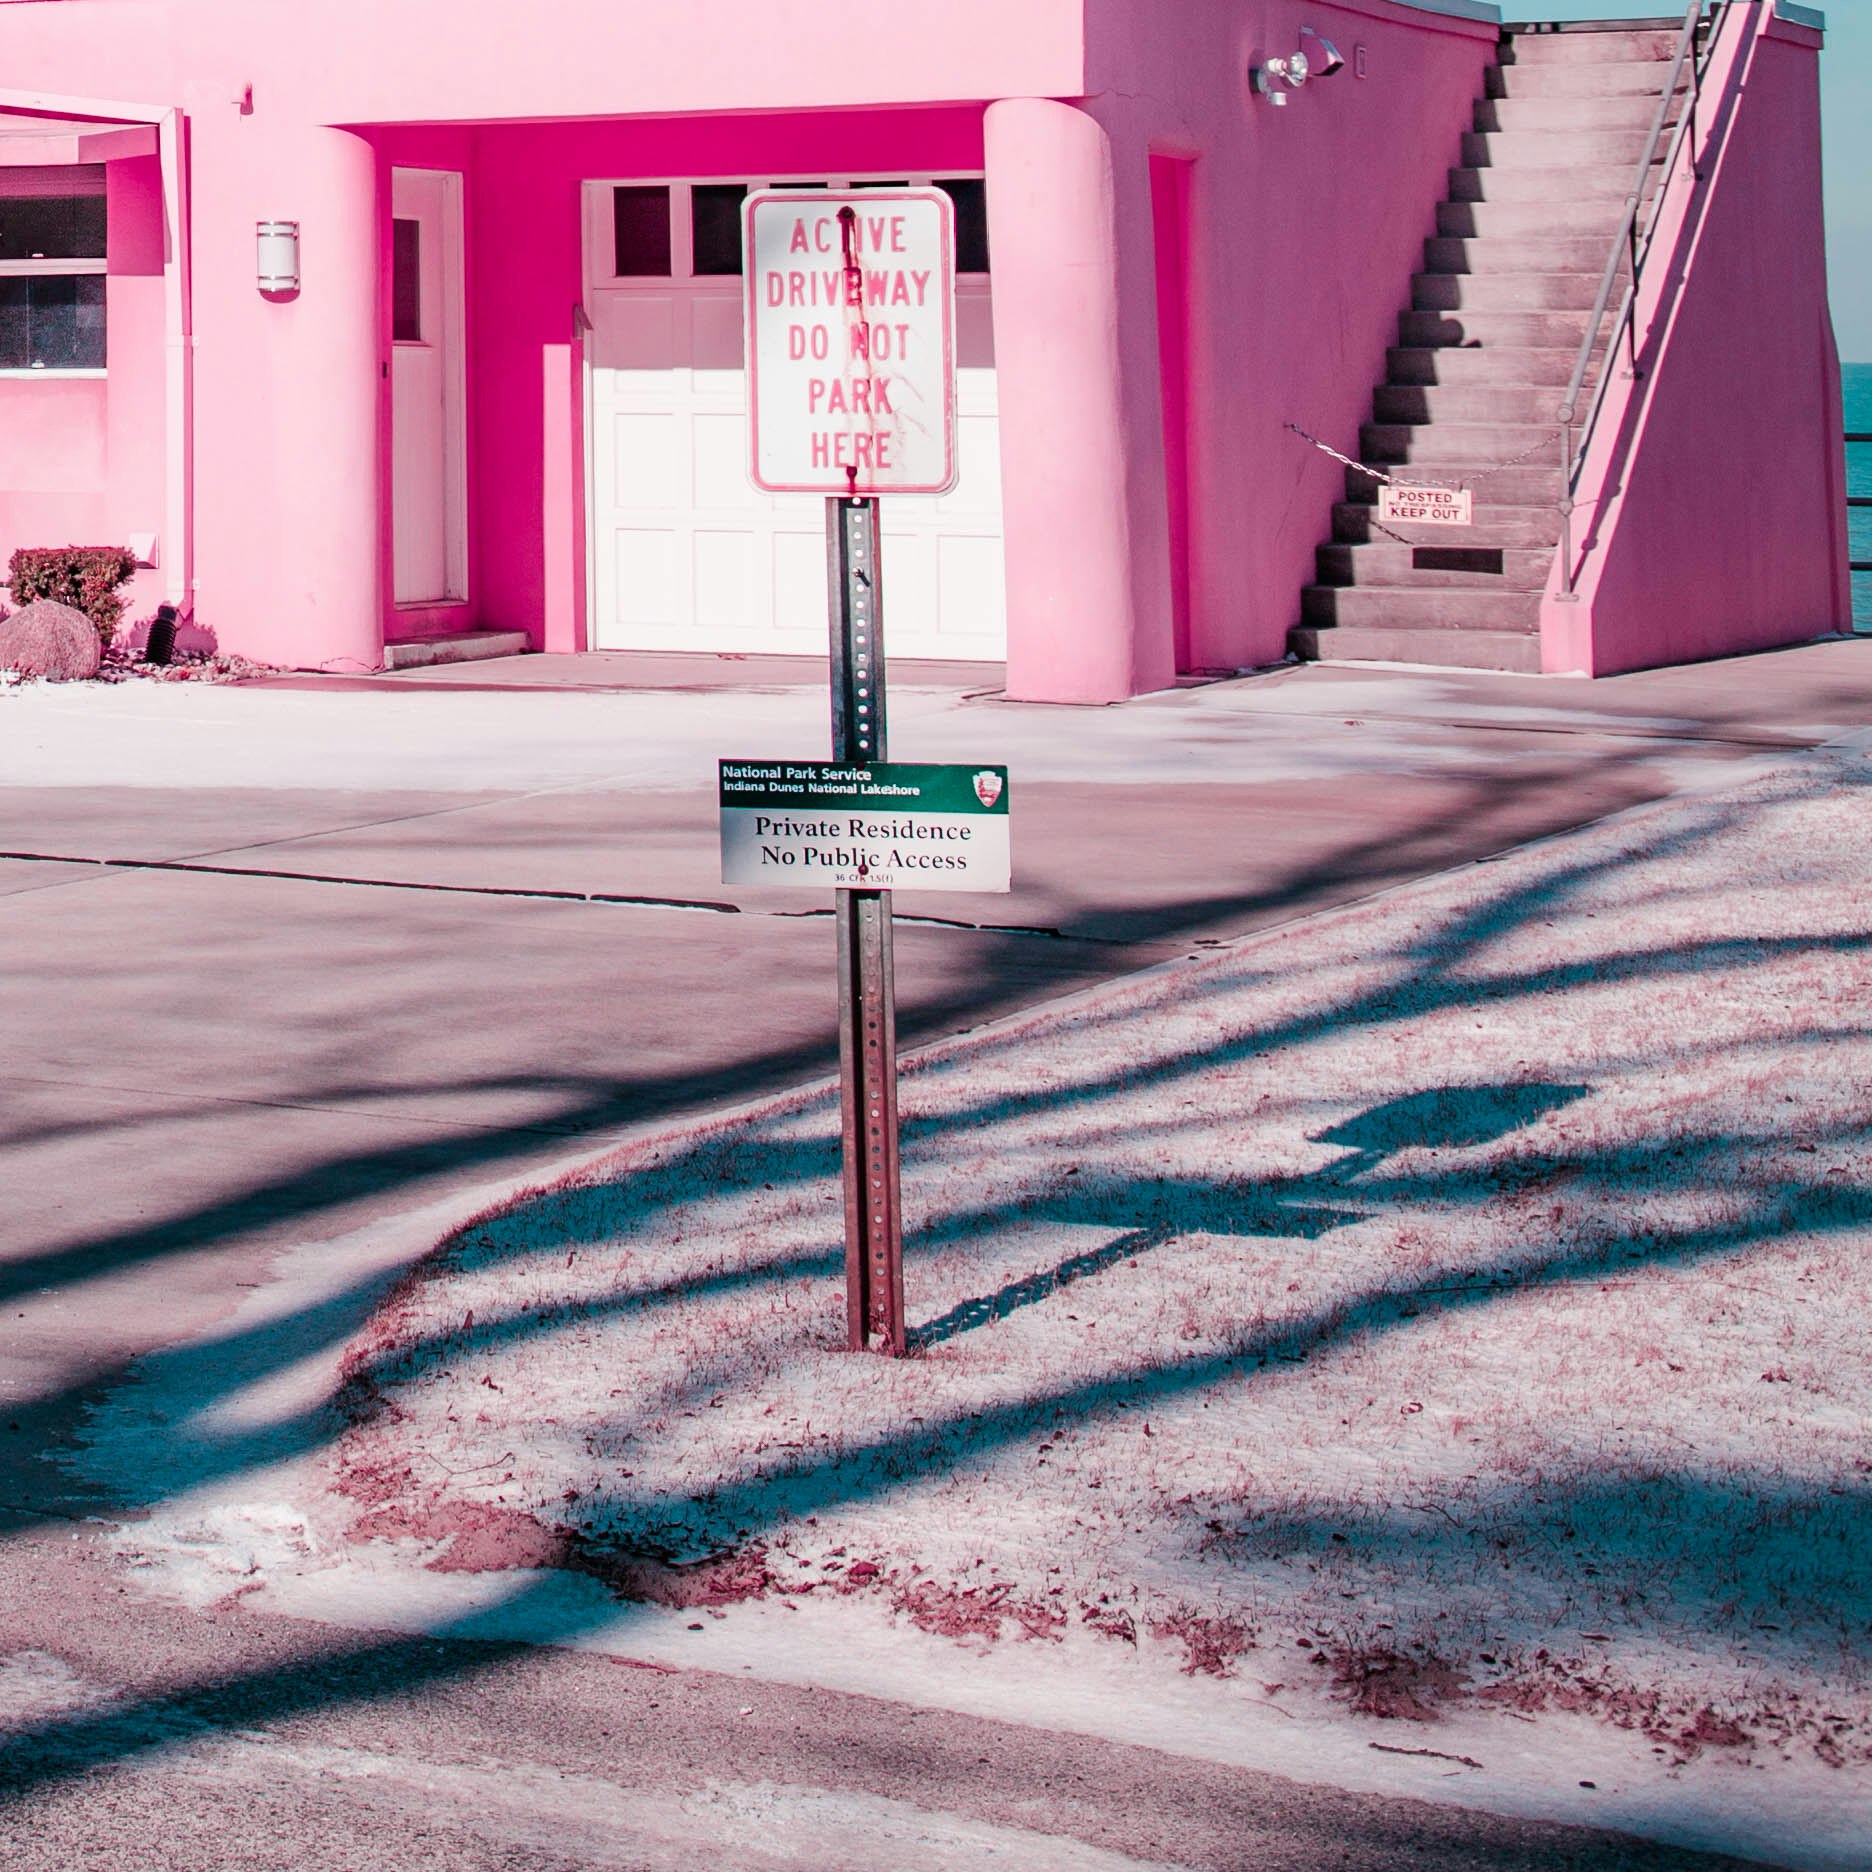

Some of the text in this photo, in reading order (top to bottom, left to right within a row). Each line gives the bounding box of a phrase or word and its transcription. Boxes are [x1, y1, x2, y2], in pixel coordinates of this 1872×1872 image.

[767, 270, 931, 307] DRIVEWAY
[789, 324, 910, 360] DO NOT
[809, 378, 893, 414] PARK
[811, 431, 892, 469] HERE
[1398, 491, 1452, 503] POSTED
[1391, 507, 1460, 519] KEEP OUT
[723, 766, 872, 781] National Park Service
[723, 782, 921, 796] Indiana Dunes National Lakeshore
[755, 816, 972, 840] Private Residence
[761, 845, 967, 869] No Public Access
[835, 874, 845, 882] 36
